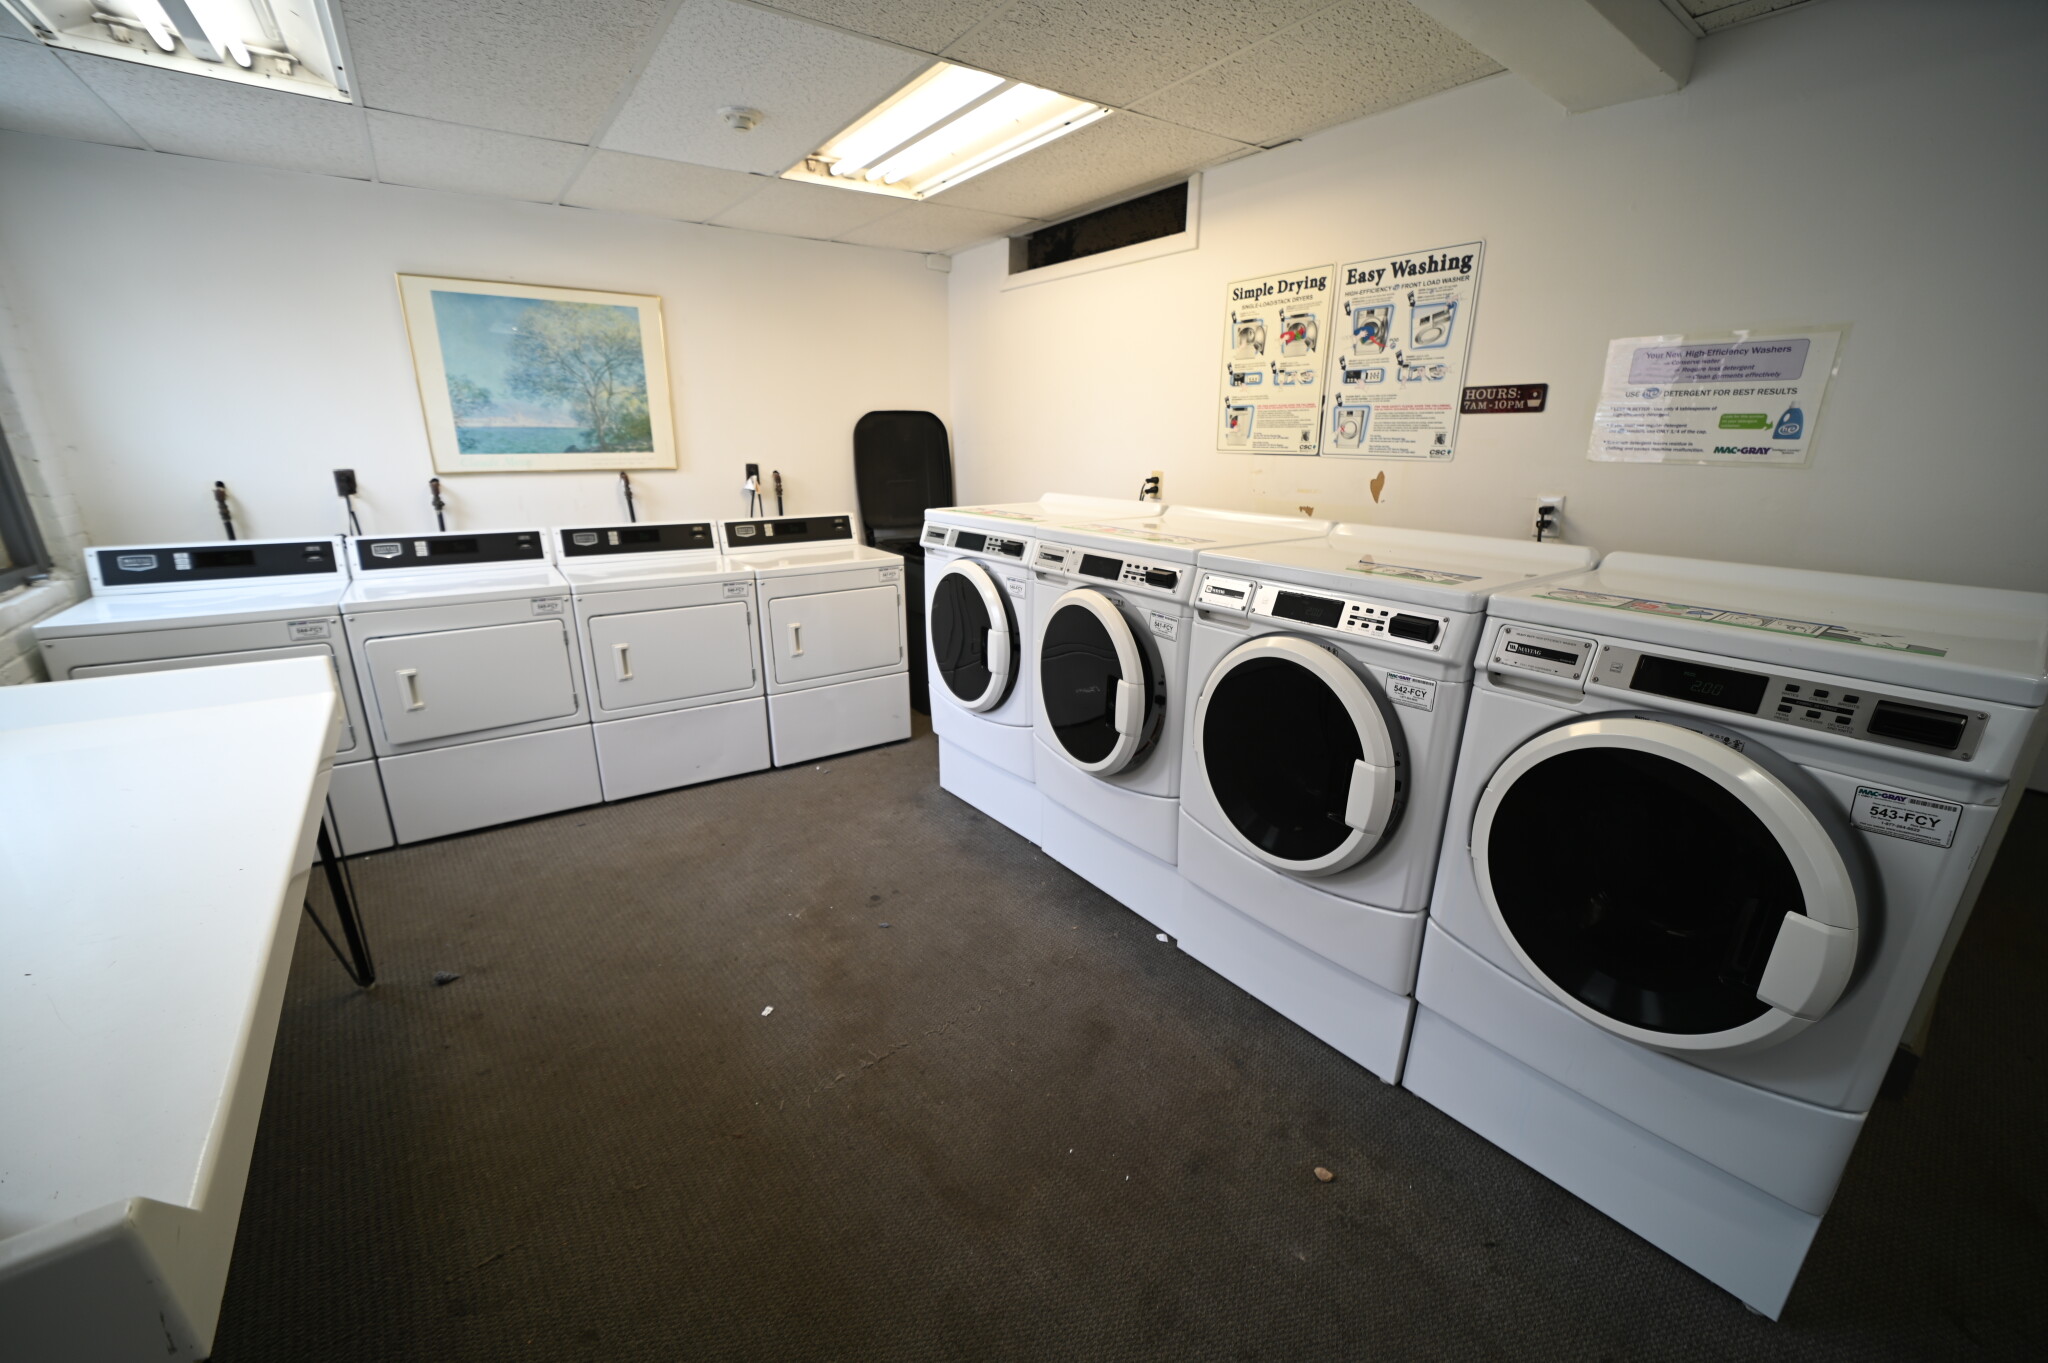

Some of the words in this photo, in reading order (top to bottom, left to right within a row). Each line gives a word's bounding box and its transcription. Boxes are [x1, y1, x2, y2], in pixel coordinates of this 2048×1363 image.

[1346, 268, 1386, 286] Easy
[1391, 253, 1474, 278] Washing
[1232, 282, 1274, 301] Simple
[1277, 275, 1327, 295] Drying
[1401, 281, 1421, 289] FRONT
[1423, 279, 1441, 287] LOAD
[1442, 275, 1470, 284] WASHER
[1645, 352, 1664, 360] Your
[1685, 348, 1749, 358] High-Efficiency
[1751, 346, 1792, 354] Washers
[1464, 388, 1521, 400] HOURS:
[1663, 389, 1711, 398] DETERGENT
[1732, 388, 1755, 396] BEST
[1757, 387, 1798, 396] RESULTS
[1518, 645, 1542, 656] MAYTAG
[1393, 684, 1427, 698] 542-FCY
[1869, 806, 1942, 828] 543-FCY
